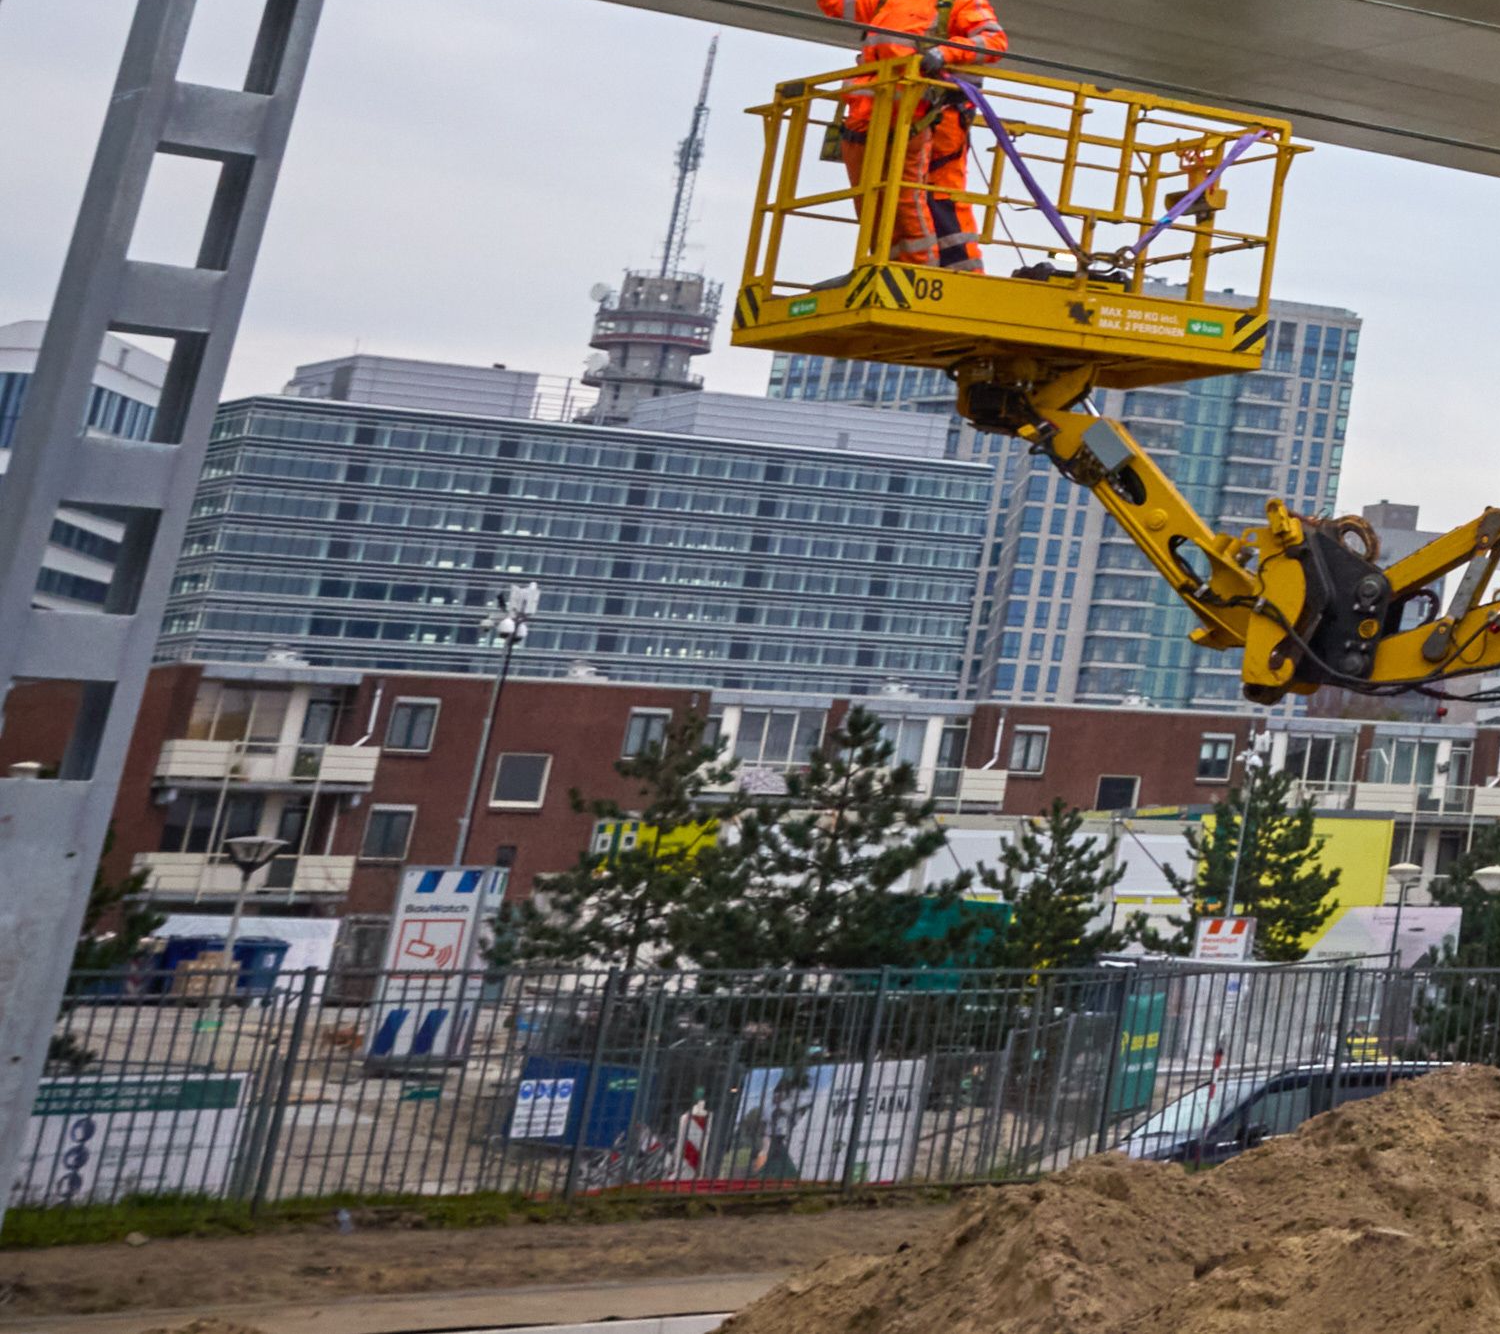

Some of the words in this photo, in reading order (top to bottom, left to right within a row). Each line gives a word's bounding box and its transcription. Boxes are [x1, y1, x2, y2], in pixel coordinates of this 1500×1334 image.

[914, 278, 944, 302] 08
[1126, 309, 1142, 321] 300
[1143, 311, 1159, 322] KG
[1124, 321, 1131, 331] 2
[1131, 322, 1185, 338] PERSONEN
[404, 904, 470, 914] BauWatch
